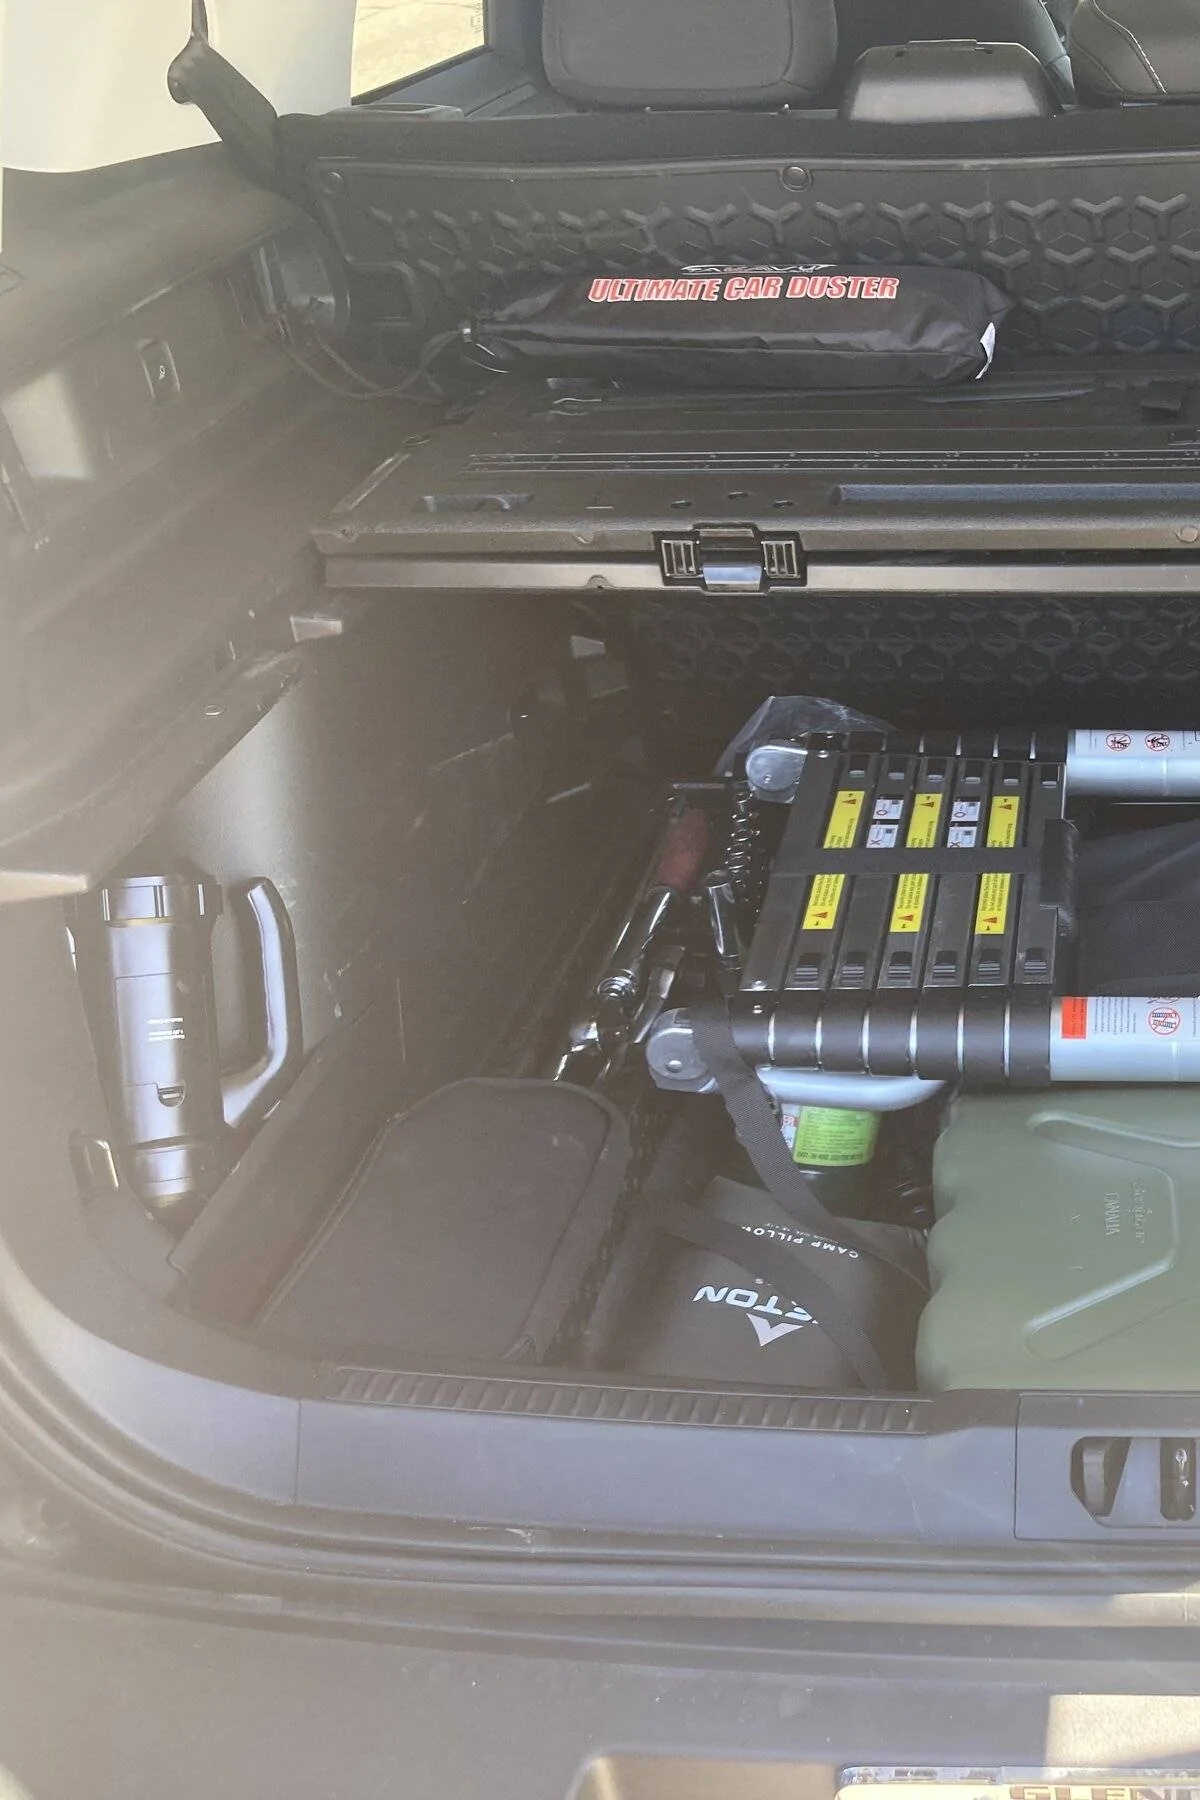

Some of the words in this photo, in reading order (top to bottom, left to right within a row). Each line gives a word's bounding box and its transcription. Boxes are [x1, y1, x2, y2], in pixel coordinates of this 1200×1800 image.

[587, 278, 722, 303] ULTIMATE
[723, 276, 782, 301] CAR
[785, 275, 900, 300] DUSTER
[810, 1241, 859, 1259] CAMP
[692, 1285, 818, 1324] ETON
